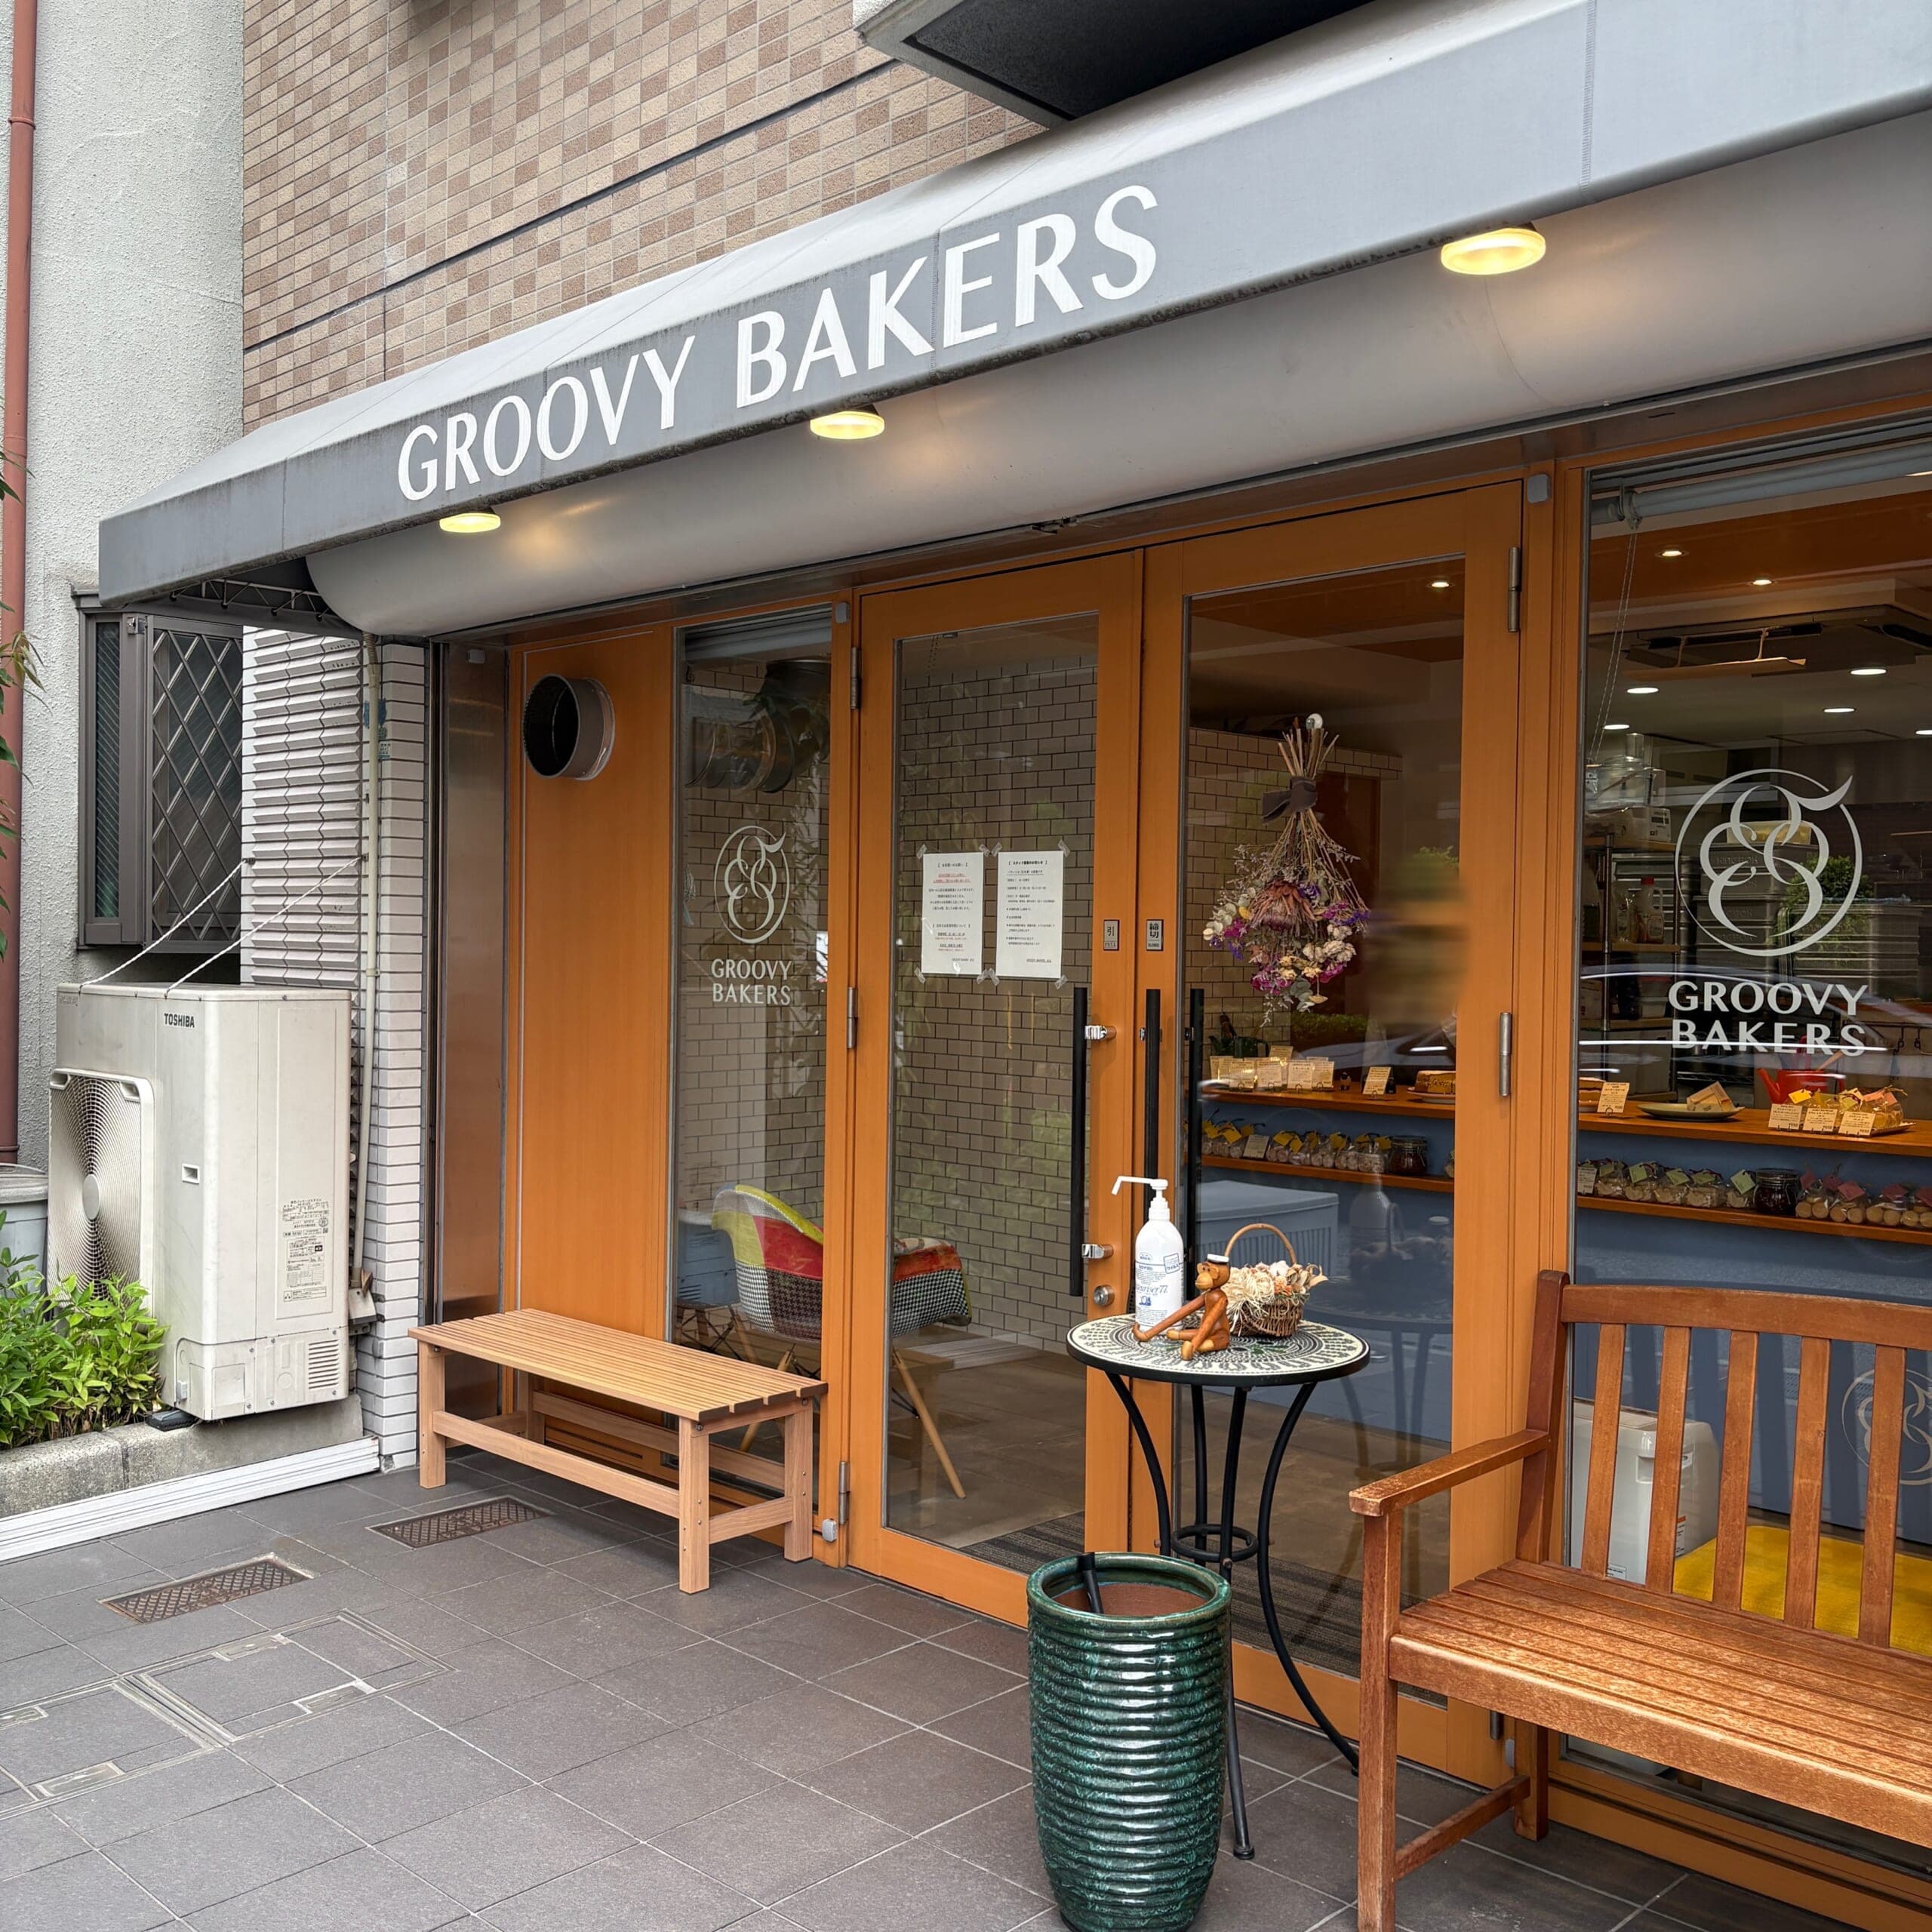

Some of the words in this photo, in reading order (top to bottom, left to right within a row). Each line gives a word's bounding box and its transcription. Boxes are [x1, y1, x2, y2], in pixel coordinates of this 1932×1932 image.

[397, 335, 695, 500] GROOVY
[736, 184, 1158, 410] BAKERS
[1106, 925, 1115, 937] 引
[711, 958, 792, 980] GROOVY
[712, 983, 791, 1006] BAKERS
[1668, 980, 1869, 1016] GROOVY
[164, 1013, 195, 1029] TOSHIBA
[1672, 1019, 1866, 1057] BAKERS
